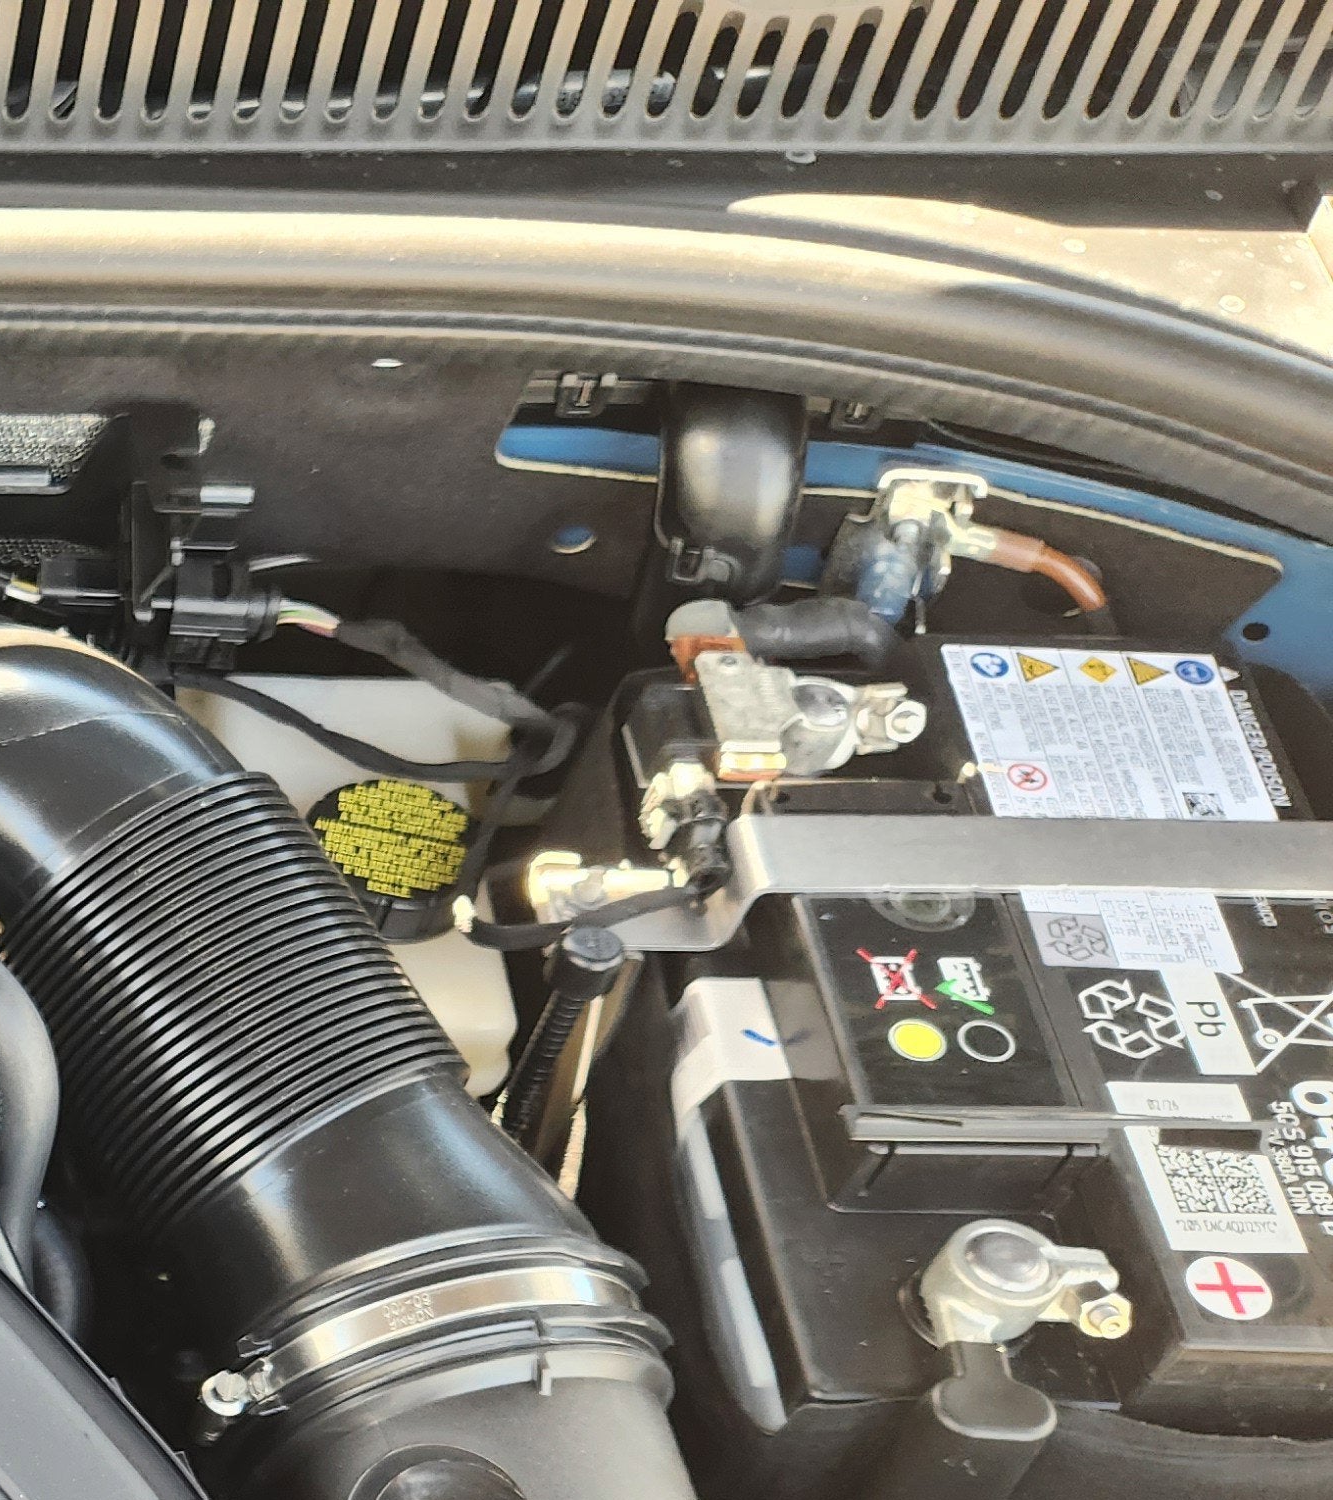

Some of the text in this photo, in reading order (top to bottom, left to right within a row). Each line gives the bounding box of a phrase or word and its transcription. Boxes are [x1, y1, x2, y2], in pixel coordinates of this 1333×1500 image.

[1229, 690, 1292, 807] DANGER/POISON
[1186, 1001, 1227, 1037] Pb
[1290, 1145, 1322, 1177] 915
[1286, 1187, 1315, 1215] DIN
